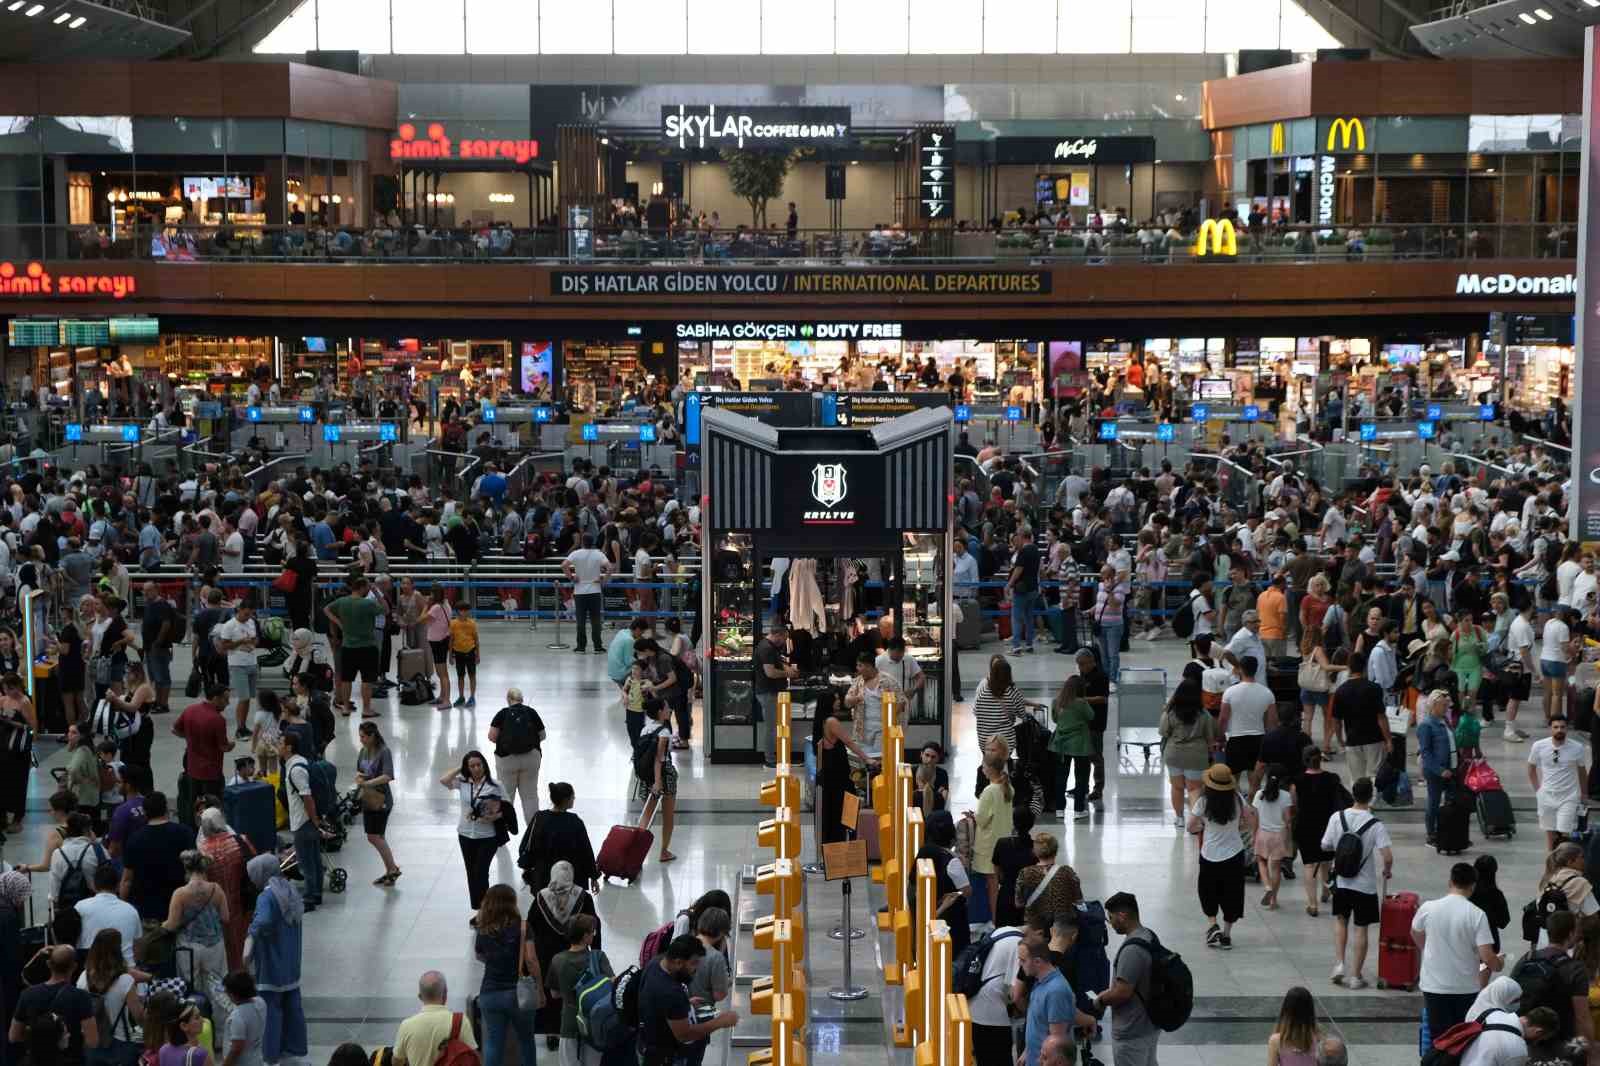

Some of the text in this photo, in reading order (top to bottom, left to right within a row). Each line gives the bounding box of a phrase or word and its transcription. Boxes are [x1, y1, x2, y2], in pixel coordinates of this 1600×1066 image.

[666, 99, 753, 149] SKYLAR
[58, 275, 136, 298] sarayı
[561, 275, 589, 294] DIŞ
[594, 275, 659, 292] HATLAR
[663, 271, 718, 292] GİDEN
[722, 275, 778, 292] YOLCU
[793, 274, 929, 292] INTERNATIONAL
[935, 274, 1040, 292] DEPARTURES
[676, 322, 903, 340] SABİHA GÖKÇEN DUTY FREE
[958, 408, 967, 418] 21
[1008, 408, 1020, 418] 22
